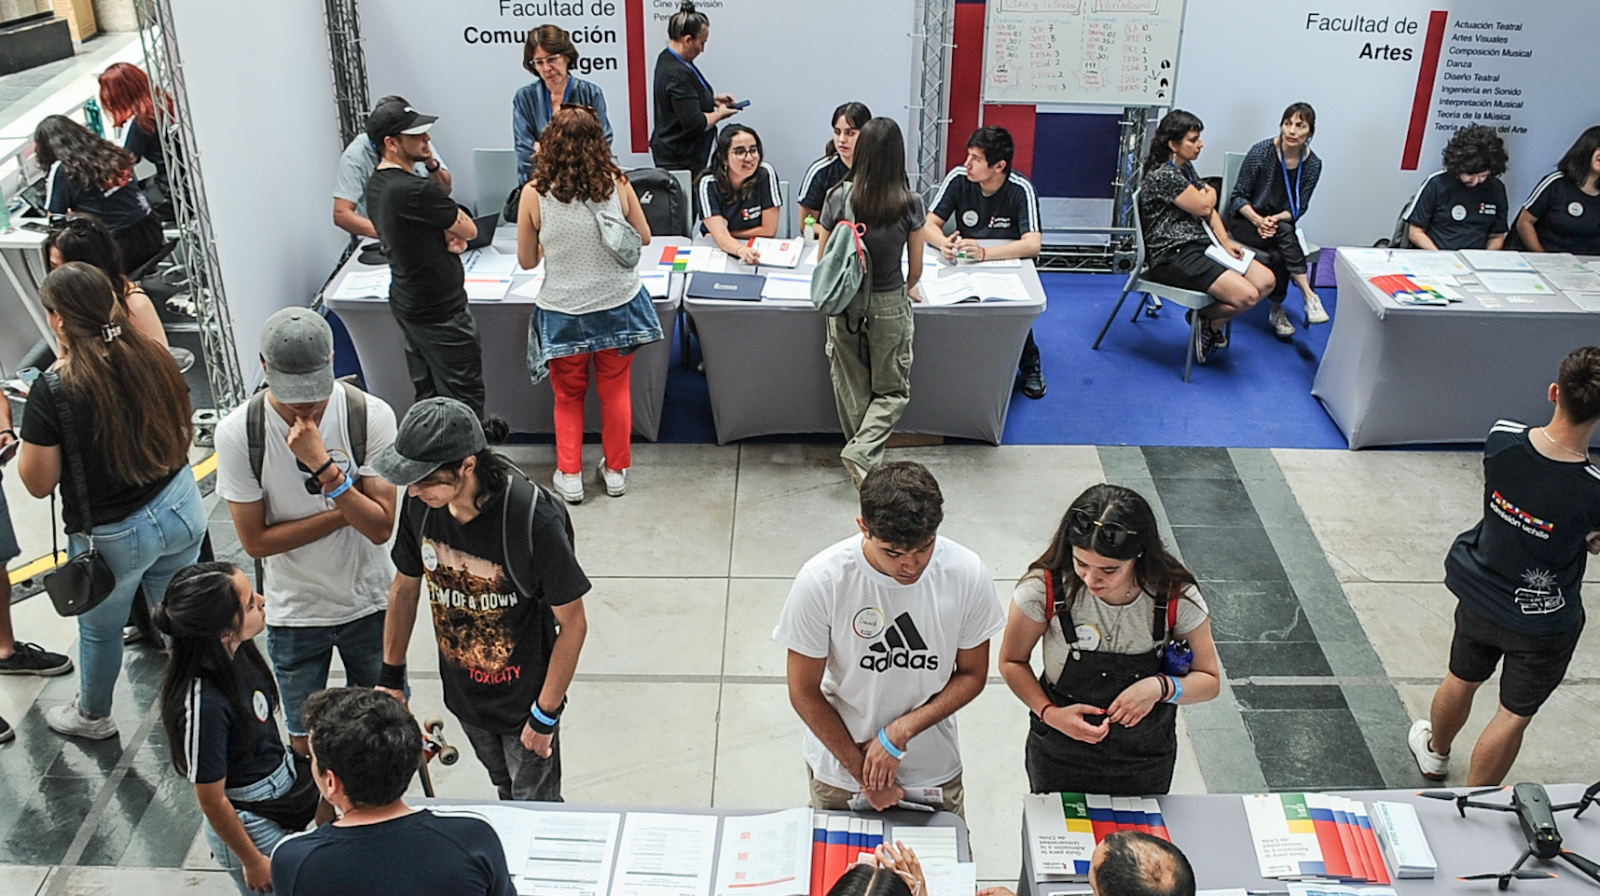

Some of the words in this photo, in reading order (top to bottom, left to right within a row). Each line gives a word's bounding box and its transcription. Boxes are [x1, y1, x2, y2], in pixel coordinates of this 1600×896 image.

[499, 0, 584, 16] Facultad
[591, 0, 615, 16] de
[1306, 13, 1389, 33] Facultad
[1394, 16, 1418, 34] de
[1454, 20, 1493, 30] Actuación
[1496, 22, 1523, 31] Teatral
[464, 26, 617, 44] Comución
[1452, 33, 1472, 42] Artes
[1475, 34, 1509, 44] Visuales
[1359, 43, 1413, 61] Artes
[1449, 46, 1500, 56] Composición
[1502, 48, 1532, 58] Musical
[1446, 60, 1472, 68] Danza
[1444, 72, 1471, 82] Diseño
[1474, 74, 1500, 82] Teatral
[1441, 85, 1480, 94] Ingeniería
[1494, 86, 1522, 96] Sonido
[1439, 98, 1492, 108] Interpretación
[1494, 100, 1524, 108] Musical
[1437, 110, 1460, 118] Teoría
[1474, 111, 1482, 119] la
[1483, 112, 1511, 120] Música
[1434, 122, 1458, 131] Teoría
[1498, 125, 1510, 133] del
[1511, 126, 1528, 134] Arte
[1522, 524, 1550, 540] uchile
[452, 590, 466, 607] OF
[468, 595, 476, 611] A
[481, 592, 518, 612] DOWN
[860, 651, 938, 673] adidas
[468, 666, 522, 684] TOXICITY
